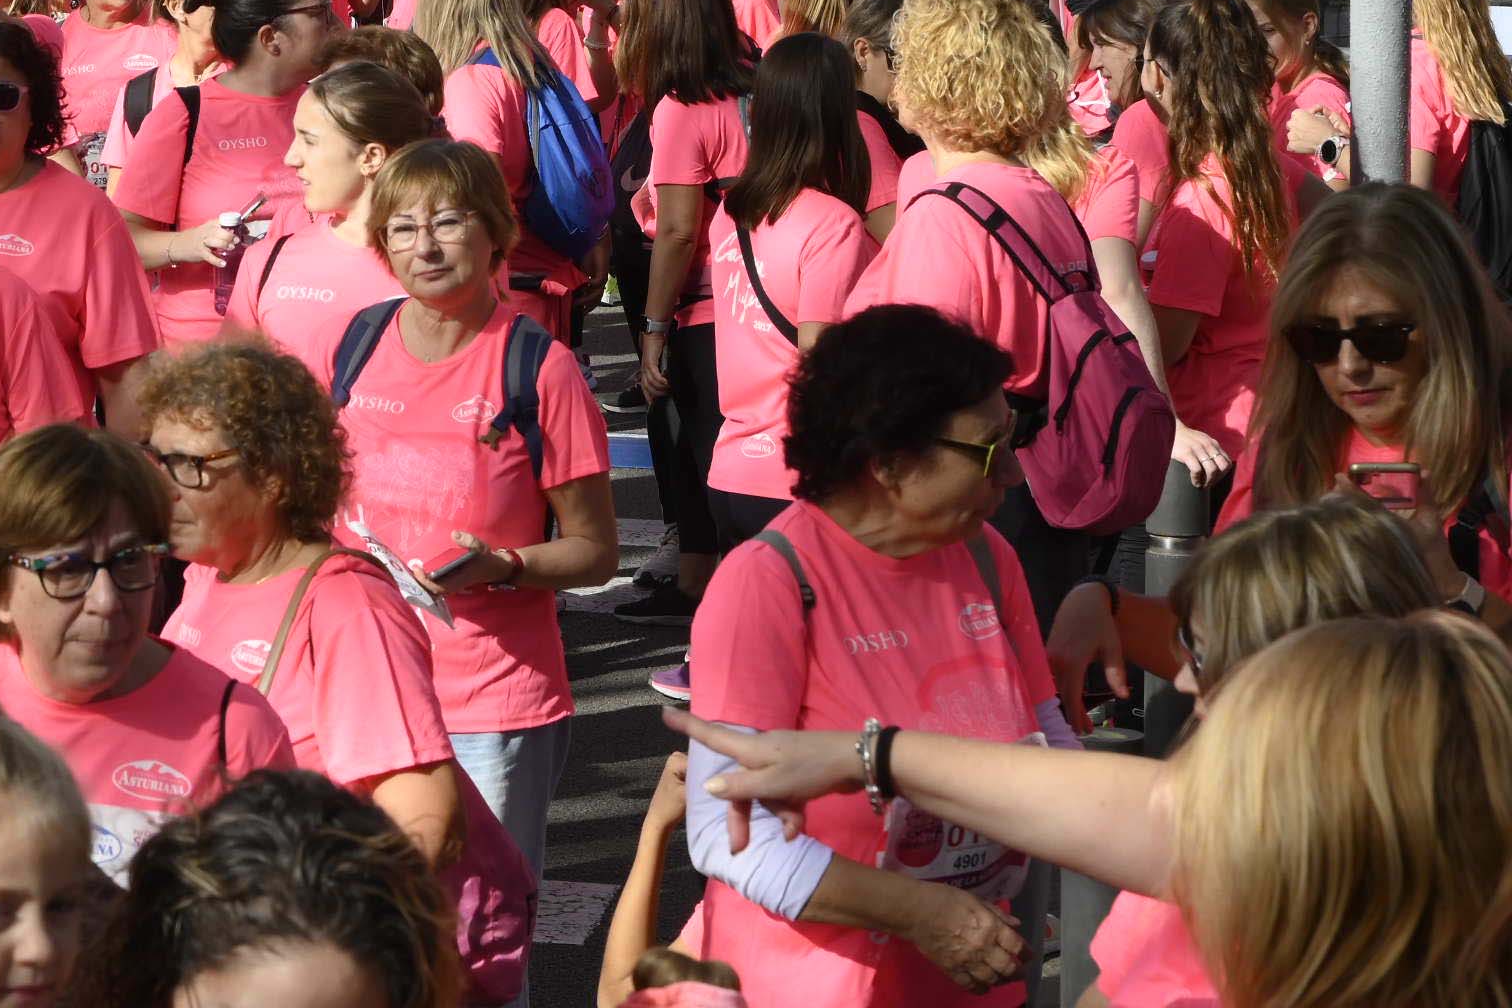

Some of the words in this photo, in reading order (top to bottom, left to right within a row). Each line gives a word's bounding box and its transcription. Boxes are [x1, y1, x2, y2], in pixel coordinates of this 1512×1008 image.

[218, 136, 268, 151] OYSHO
[90, 162, 108, 174] 01
[94, 177, 108, 185] 279
[276, 284, 335, 303] OYSHO
[119, 770, 185, 794] ASTURIANA
[953, 850, 987, 871] 4901
